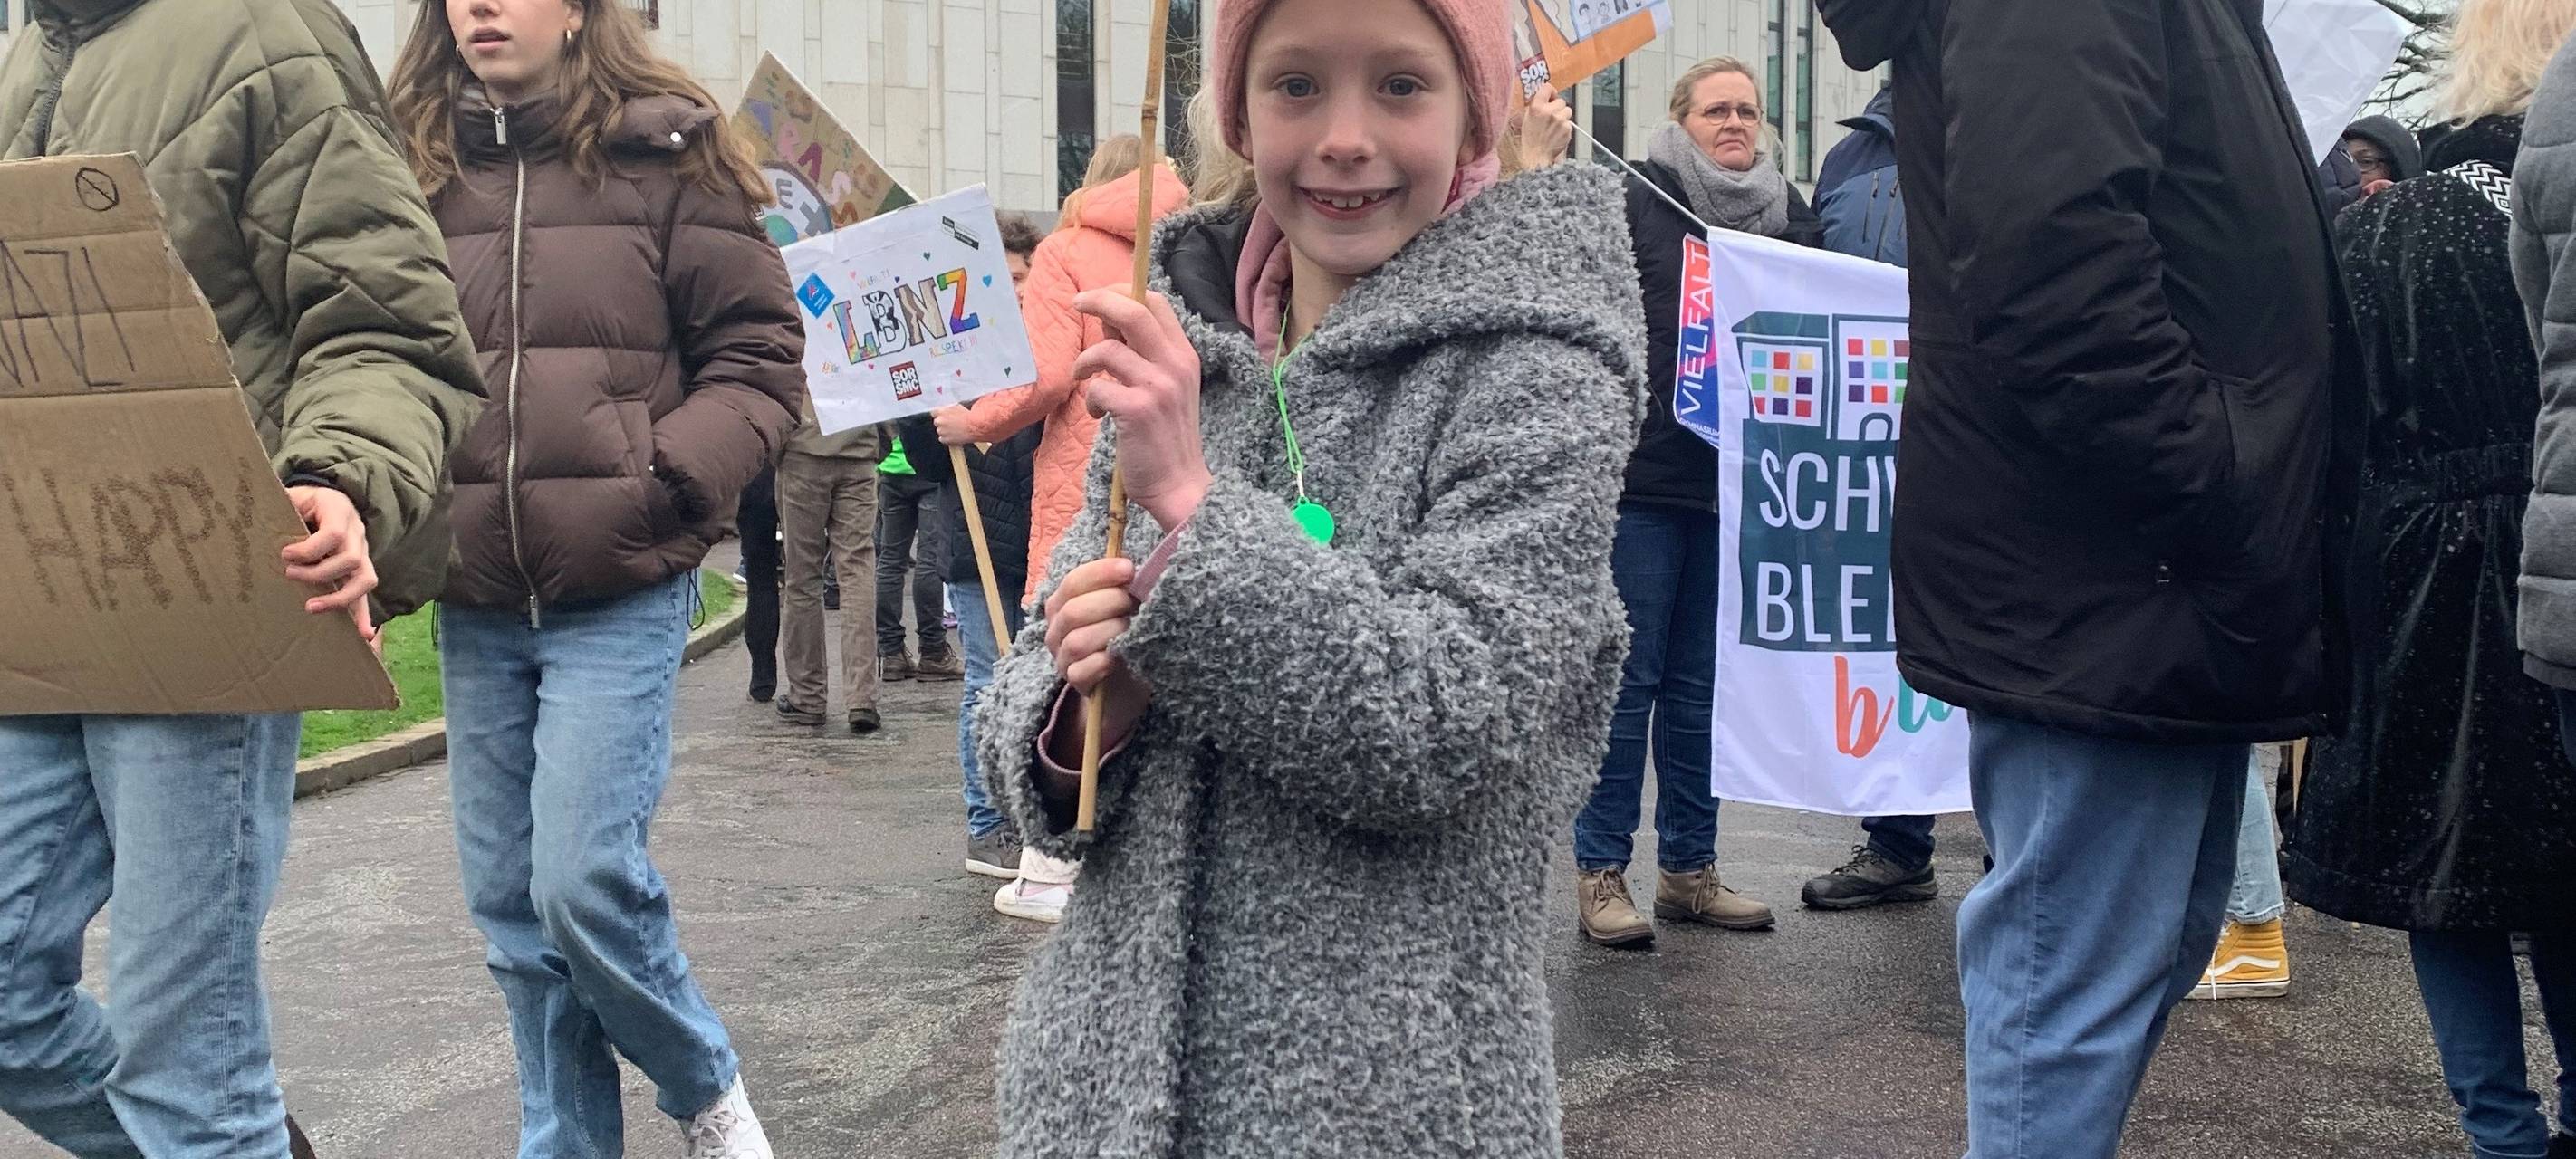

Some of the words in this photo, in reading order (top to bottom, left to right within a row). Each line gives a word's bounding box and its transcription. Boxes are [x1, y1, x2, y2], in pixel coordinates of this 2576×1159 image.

[0, 239, 135, 390] AZI
[832, 267, 981, 365] LBNZ
[1680, 243, 1714, 416] VIELFALT
[892, 368, 917, 382] SOR
[896, 378, 919, 395] SMC
